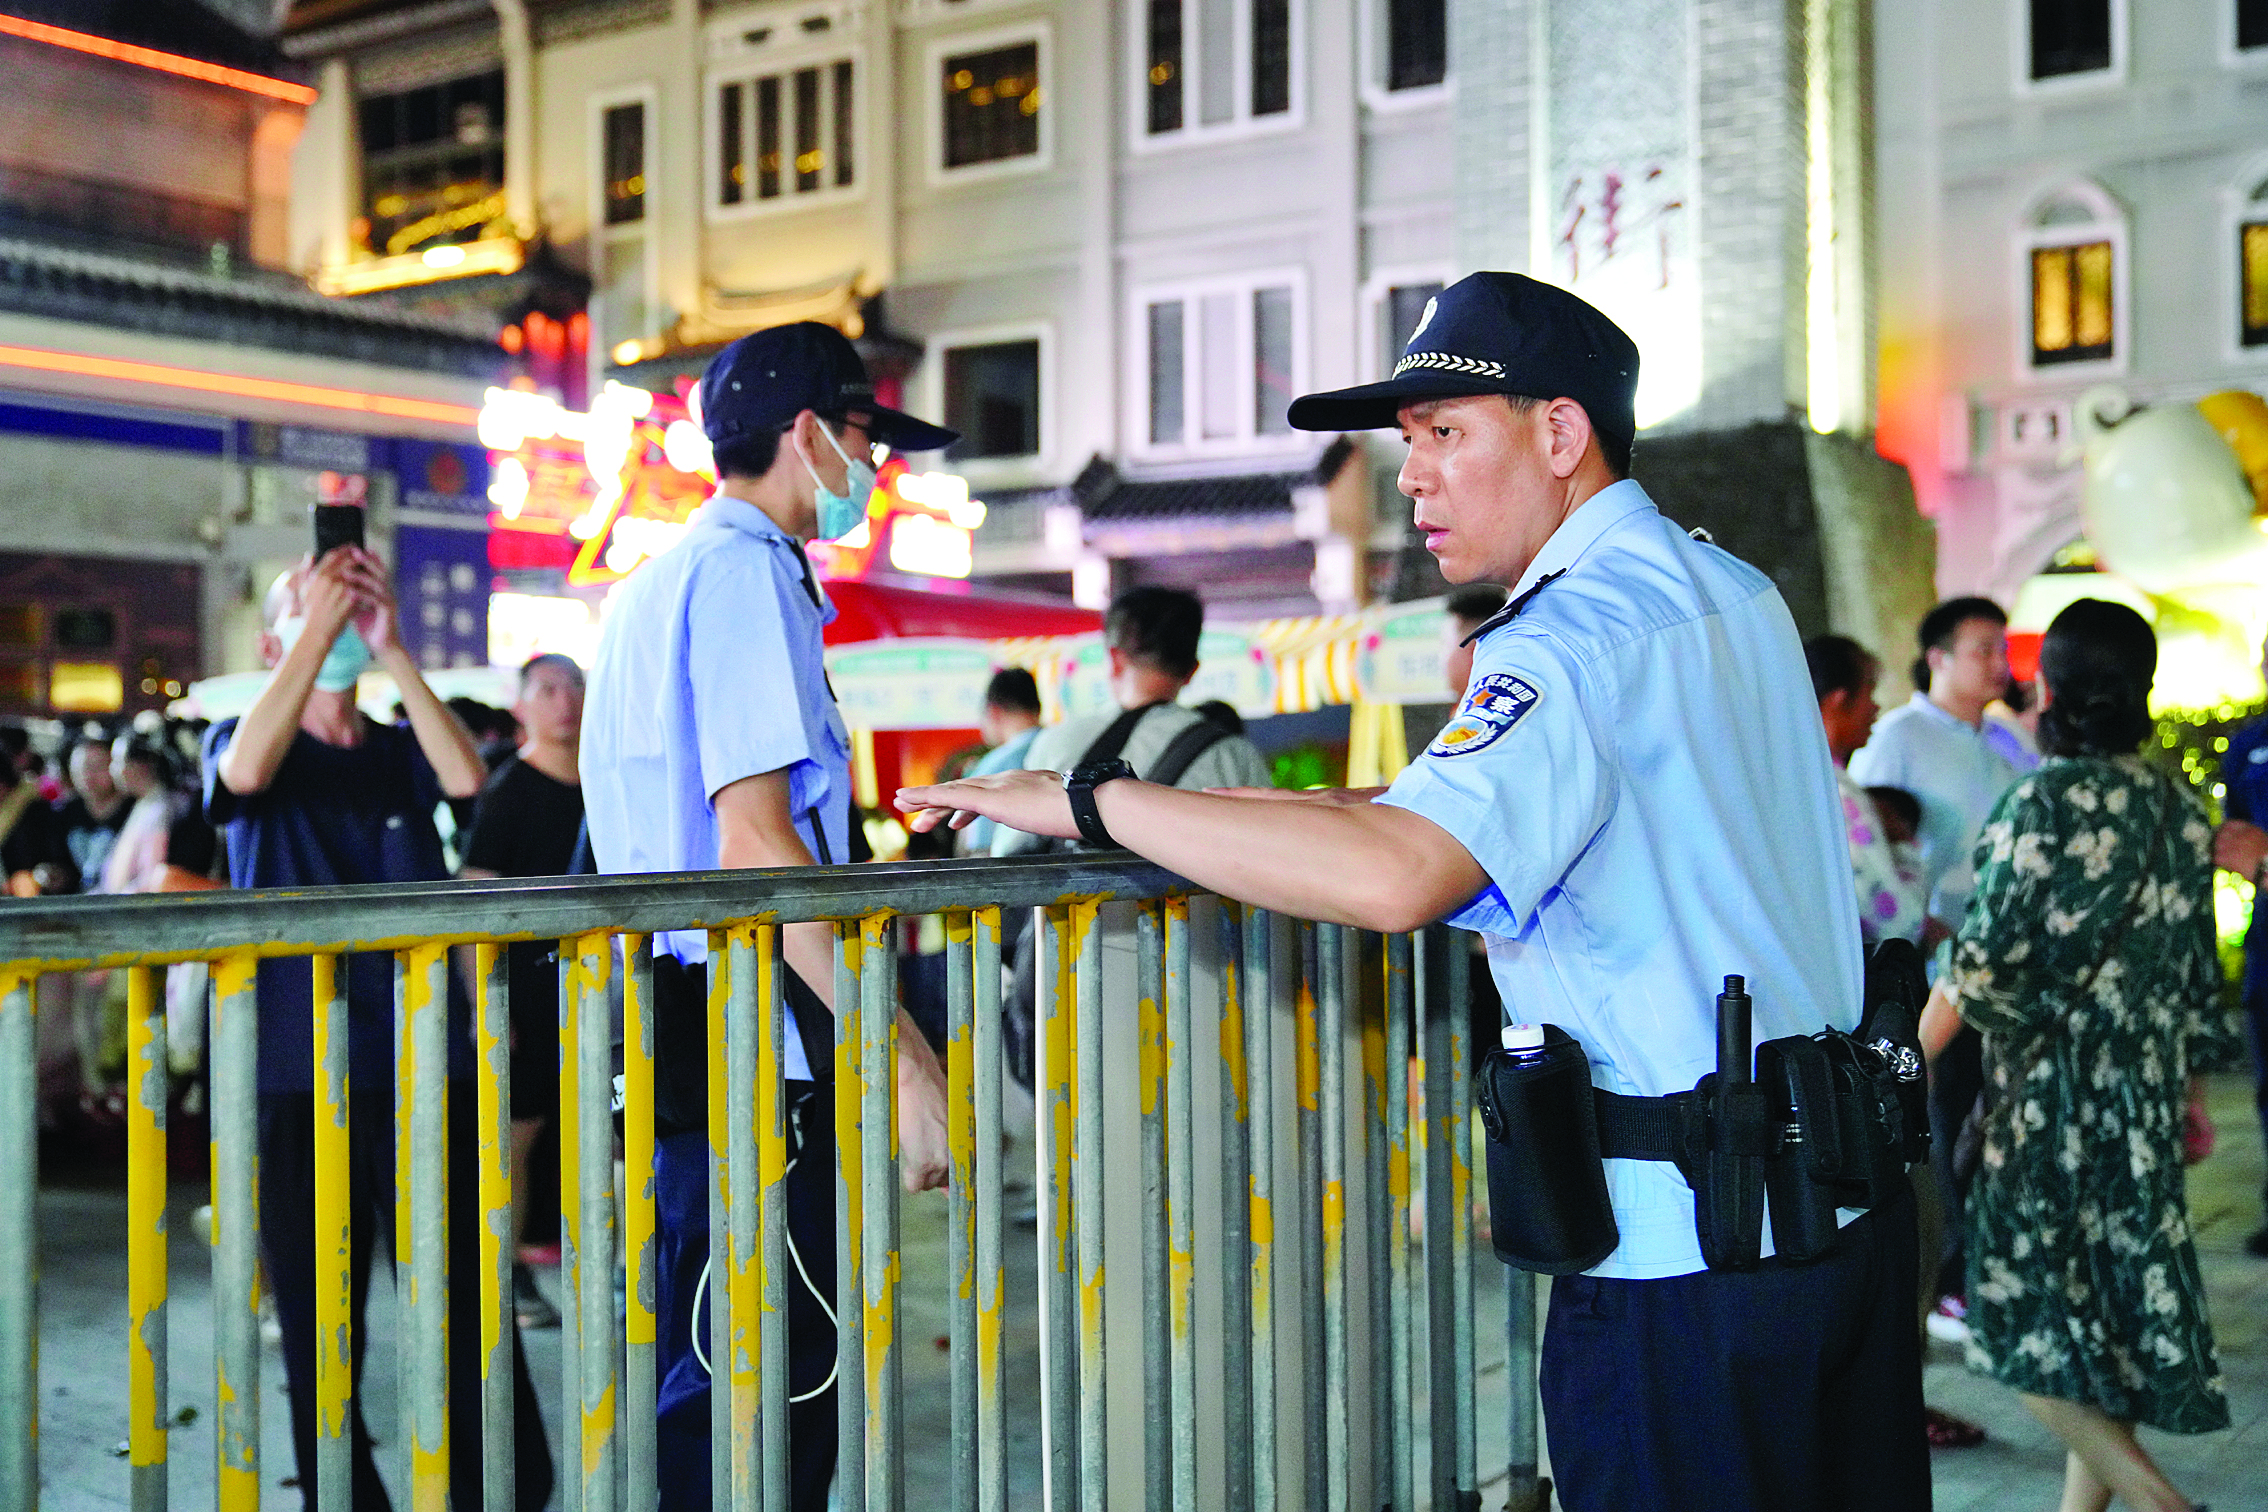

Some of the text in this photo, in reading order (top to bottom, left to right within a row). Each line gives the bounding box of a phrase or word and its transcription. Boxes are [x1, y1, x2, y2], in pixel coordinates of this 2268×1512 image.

[1467, 675, 1537, 702] 人民共和国
